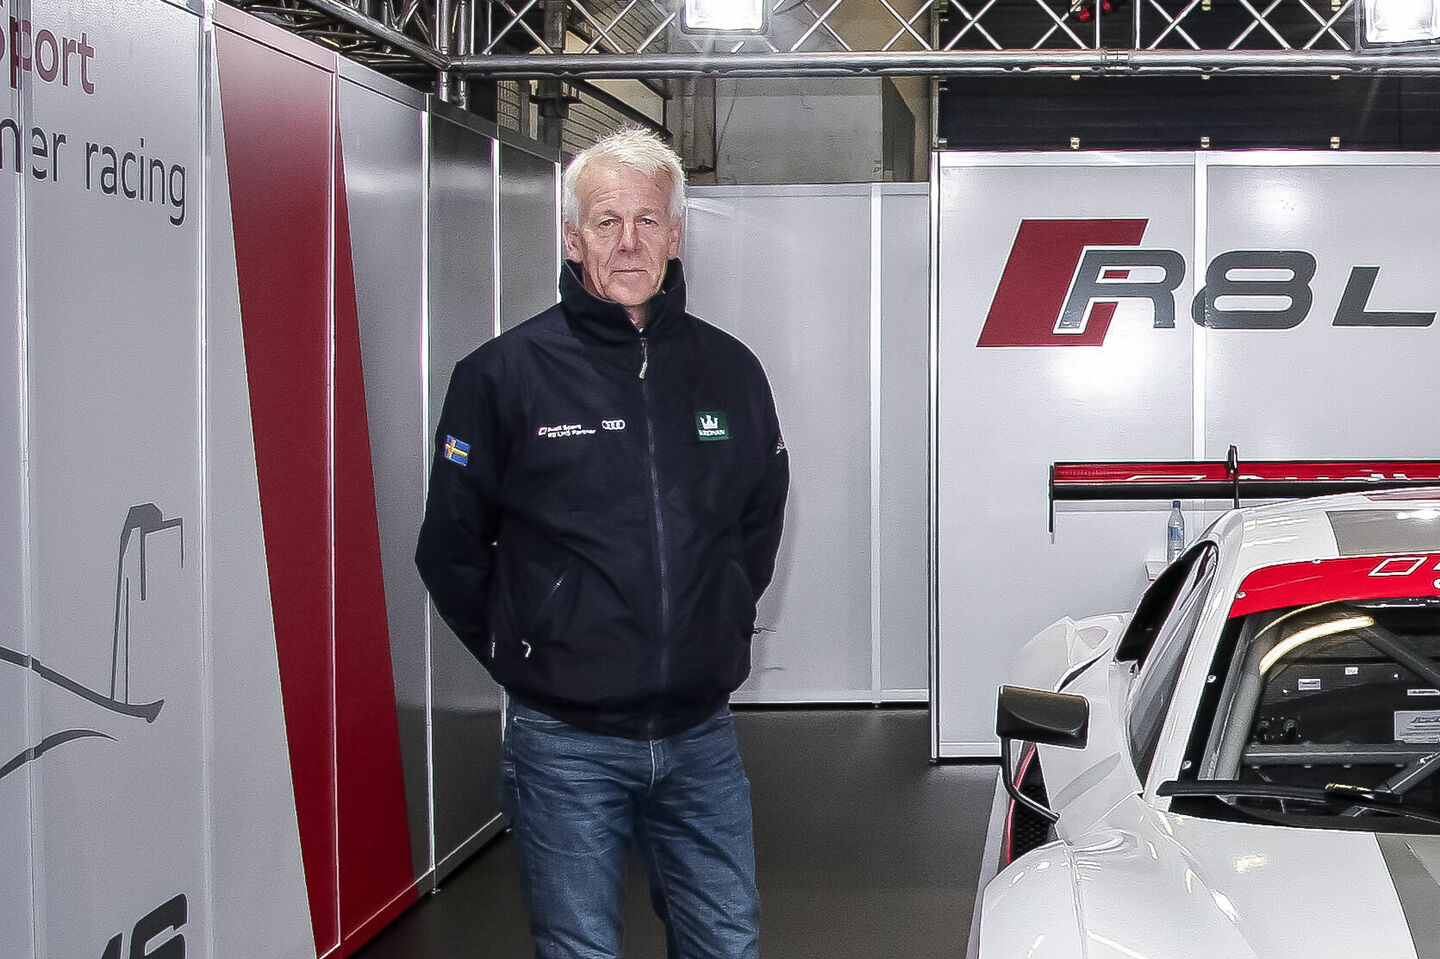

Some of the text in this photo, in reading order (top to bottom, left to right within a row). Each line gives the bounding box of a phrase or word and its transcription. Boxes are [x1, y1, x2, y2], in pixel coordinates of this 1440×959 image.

[0, 0, 95, 94] port
[85, 137, 186, 226] racing
[1056, 248, 1317, 331] R8
